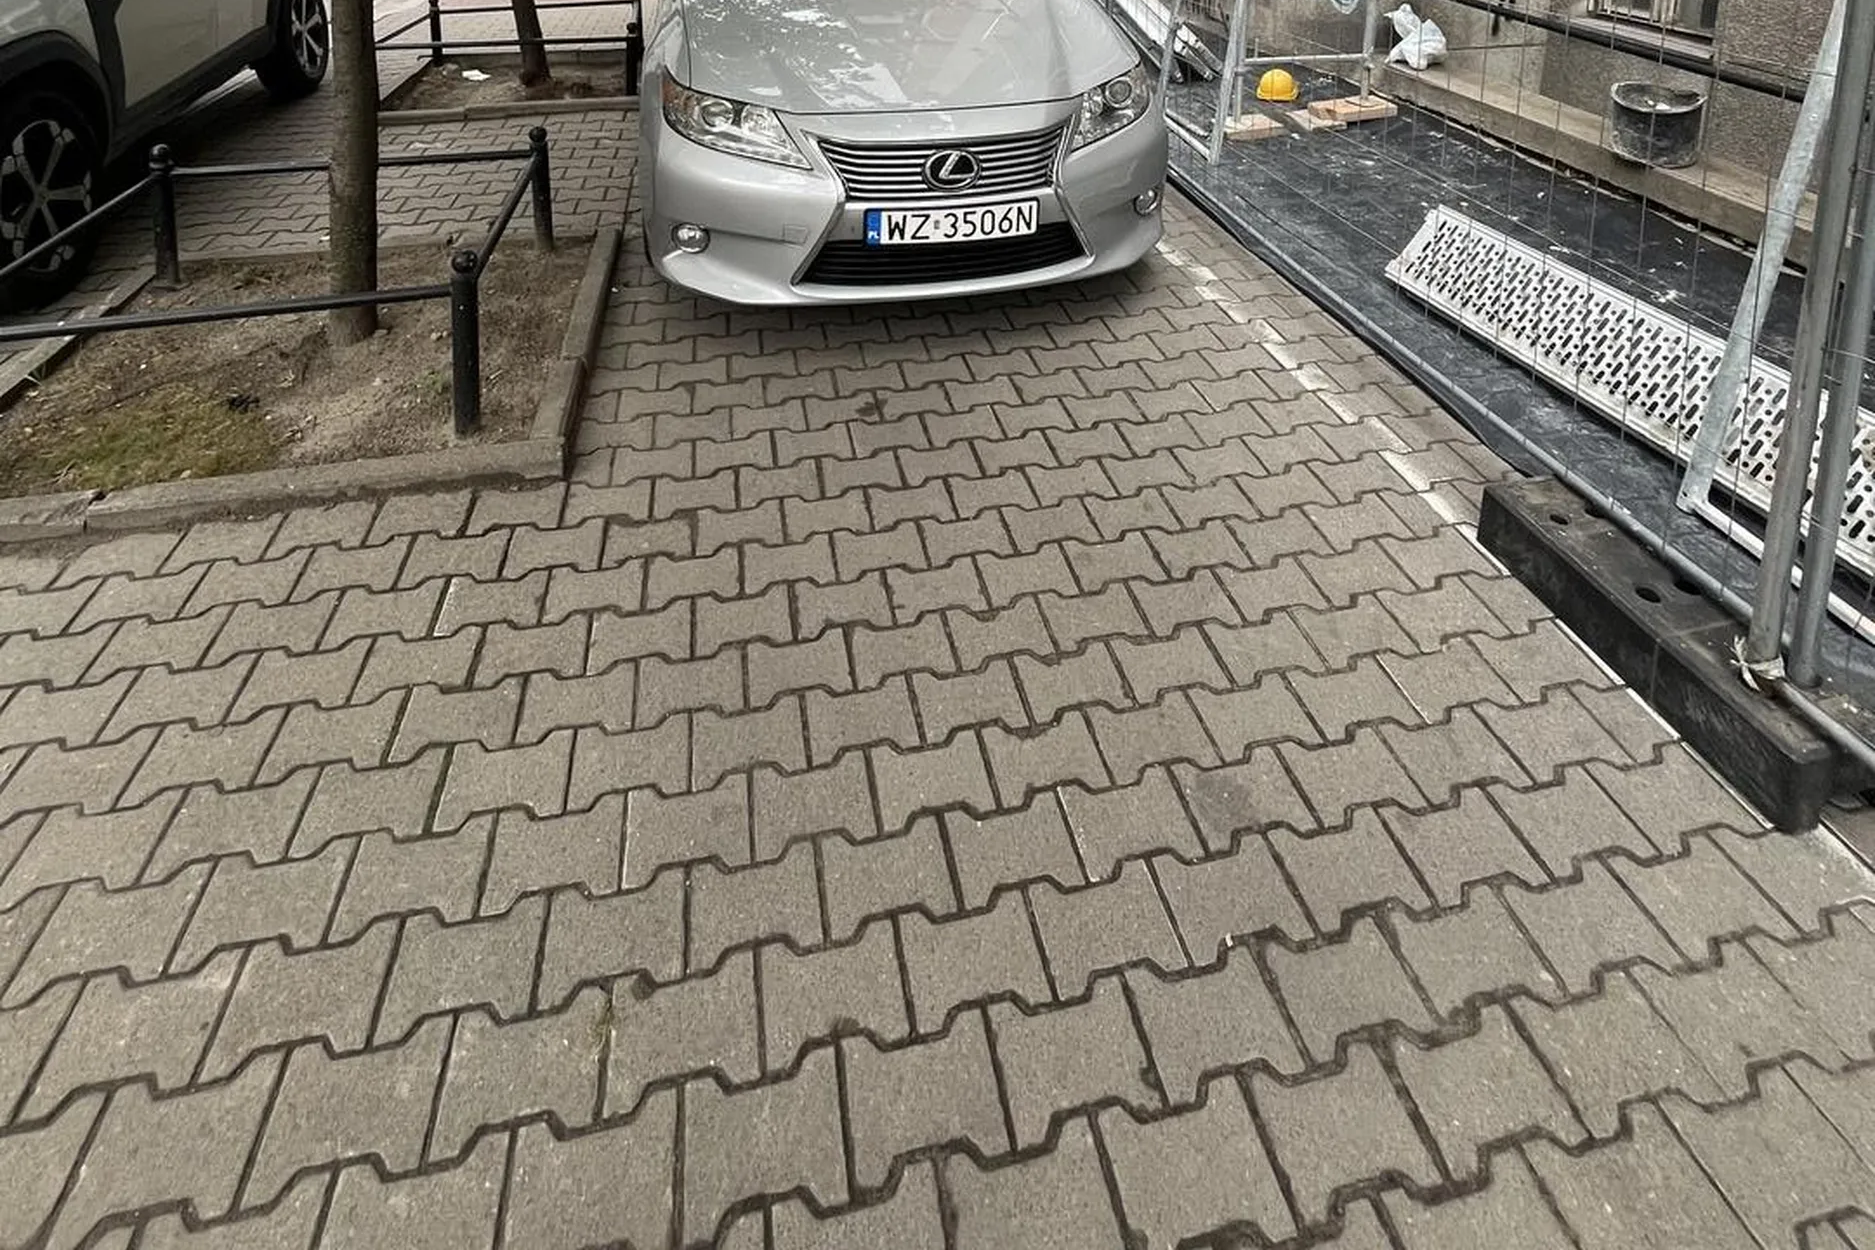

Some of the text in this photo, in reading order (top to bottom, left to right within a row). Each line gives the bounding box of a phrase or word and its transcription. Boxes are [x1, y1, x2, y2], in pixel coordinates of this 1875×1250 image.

[887, 205, 1033, 240] WZ 3506N
[867, 230, 880, 239] PL
